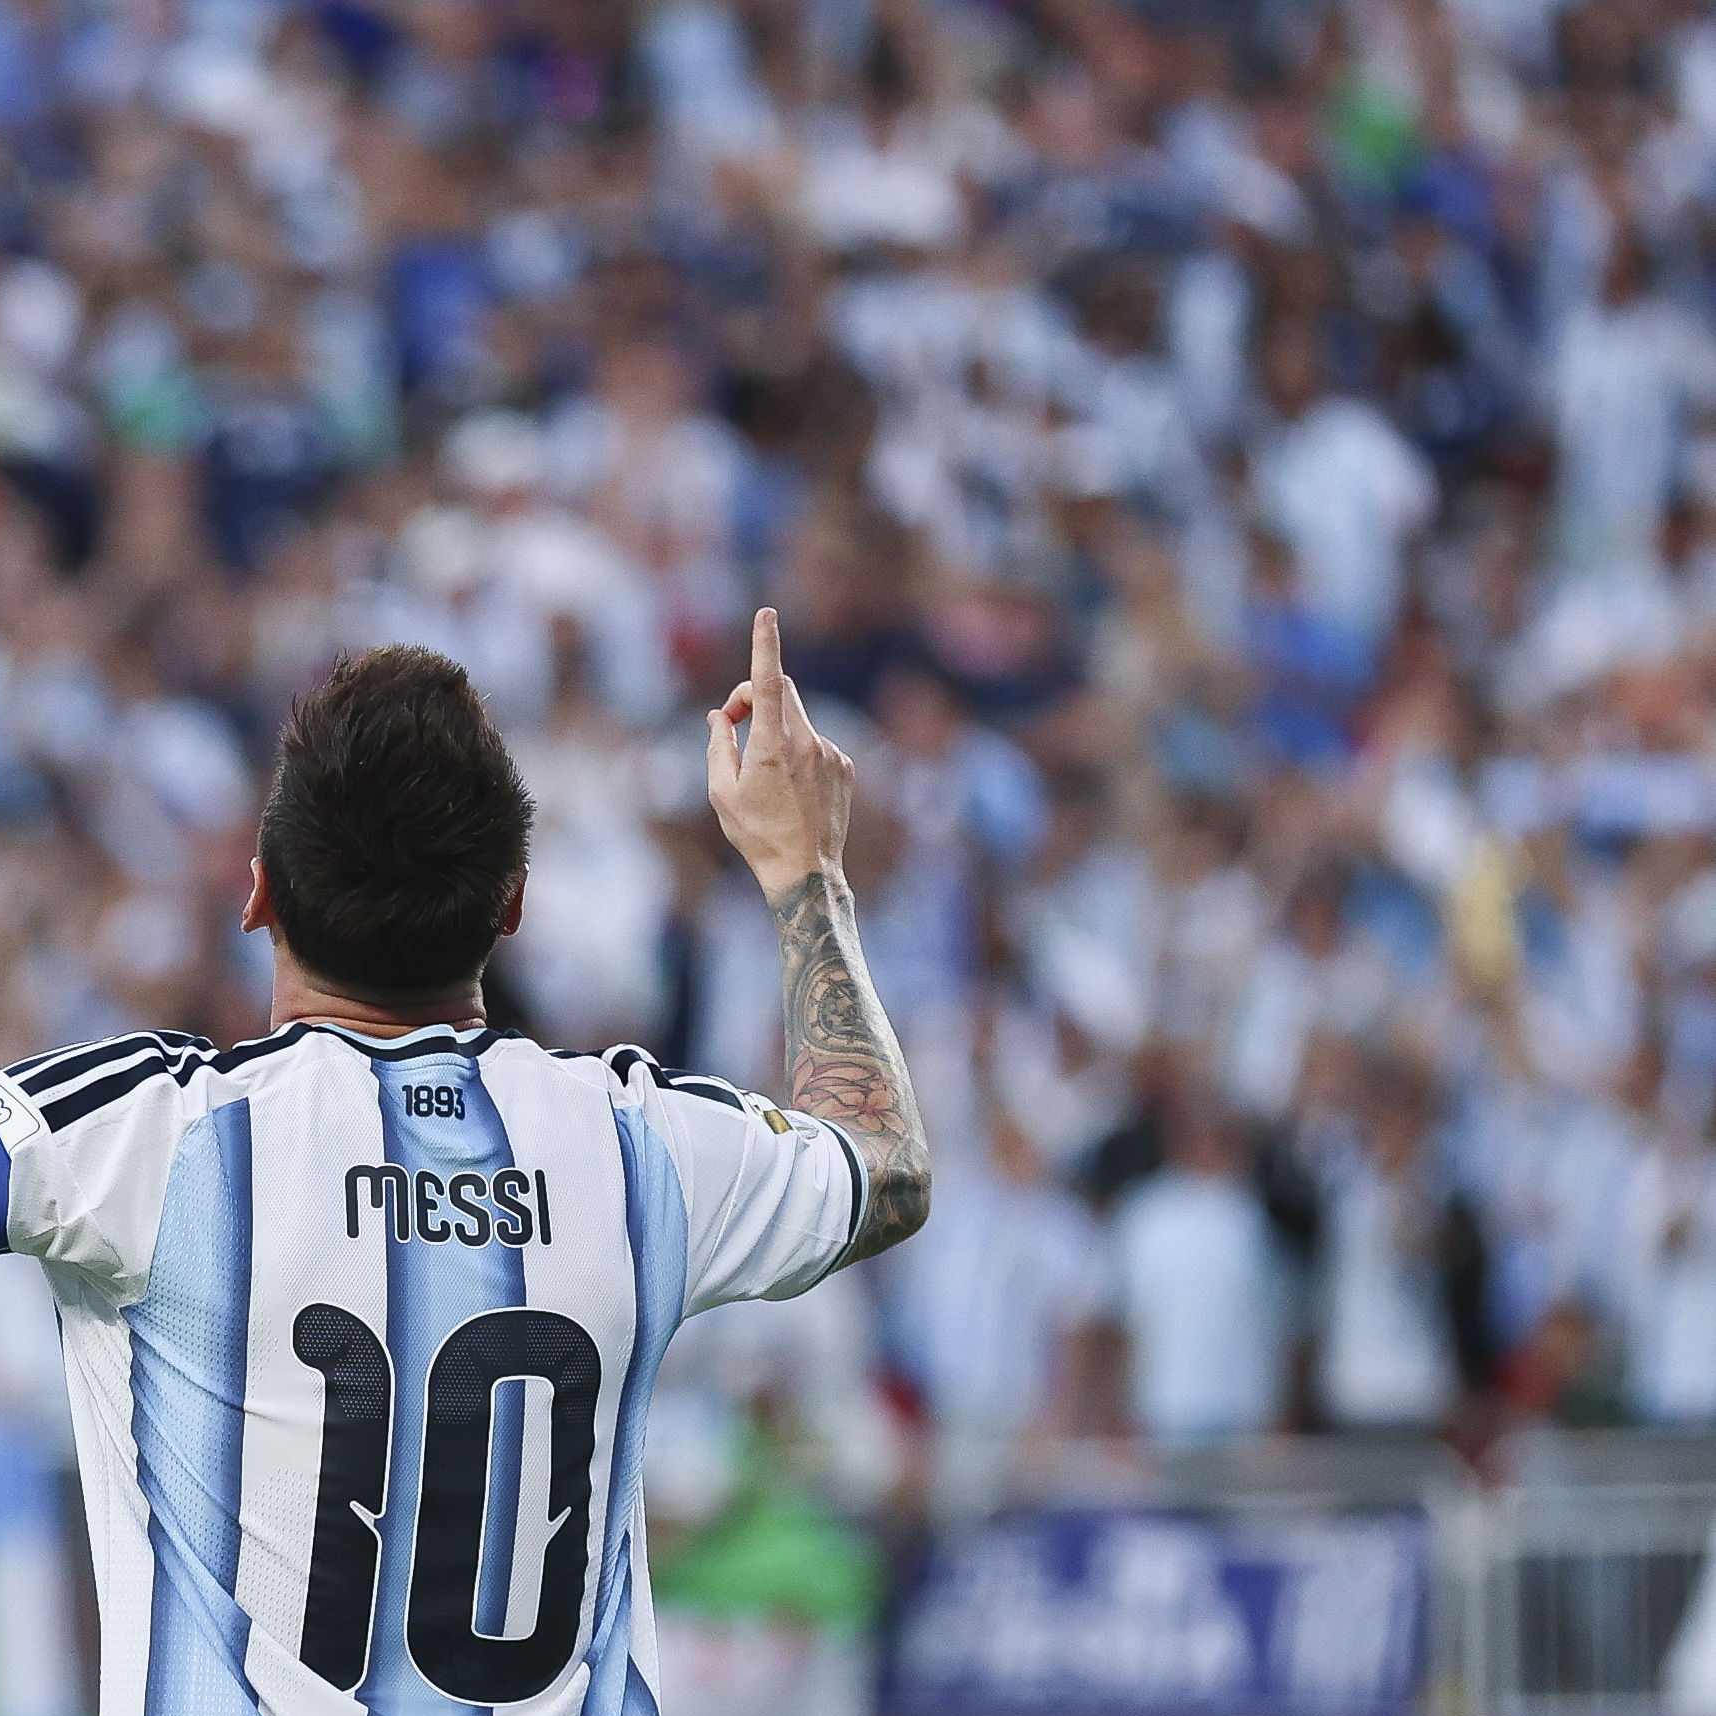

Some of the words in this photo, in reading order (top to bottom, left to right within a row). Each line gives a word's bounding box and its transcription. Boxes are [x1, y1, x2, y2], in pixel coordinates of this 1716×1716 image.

[401, 1084, 466, 1121] 1893
[344, 1163, 553, 1249] MESSI
[291, 1302, 603, 1706] 10
